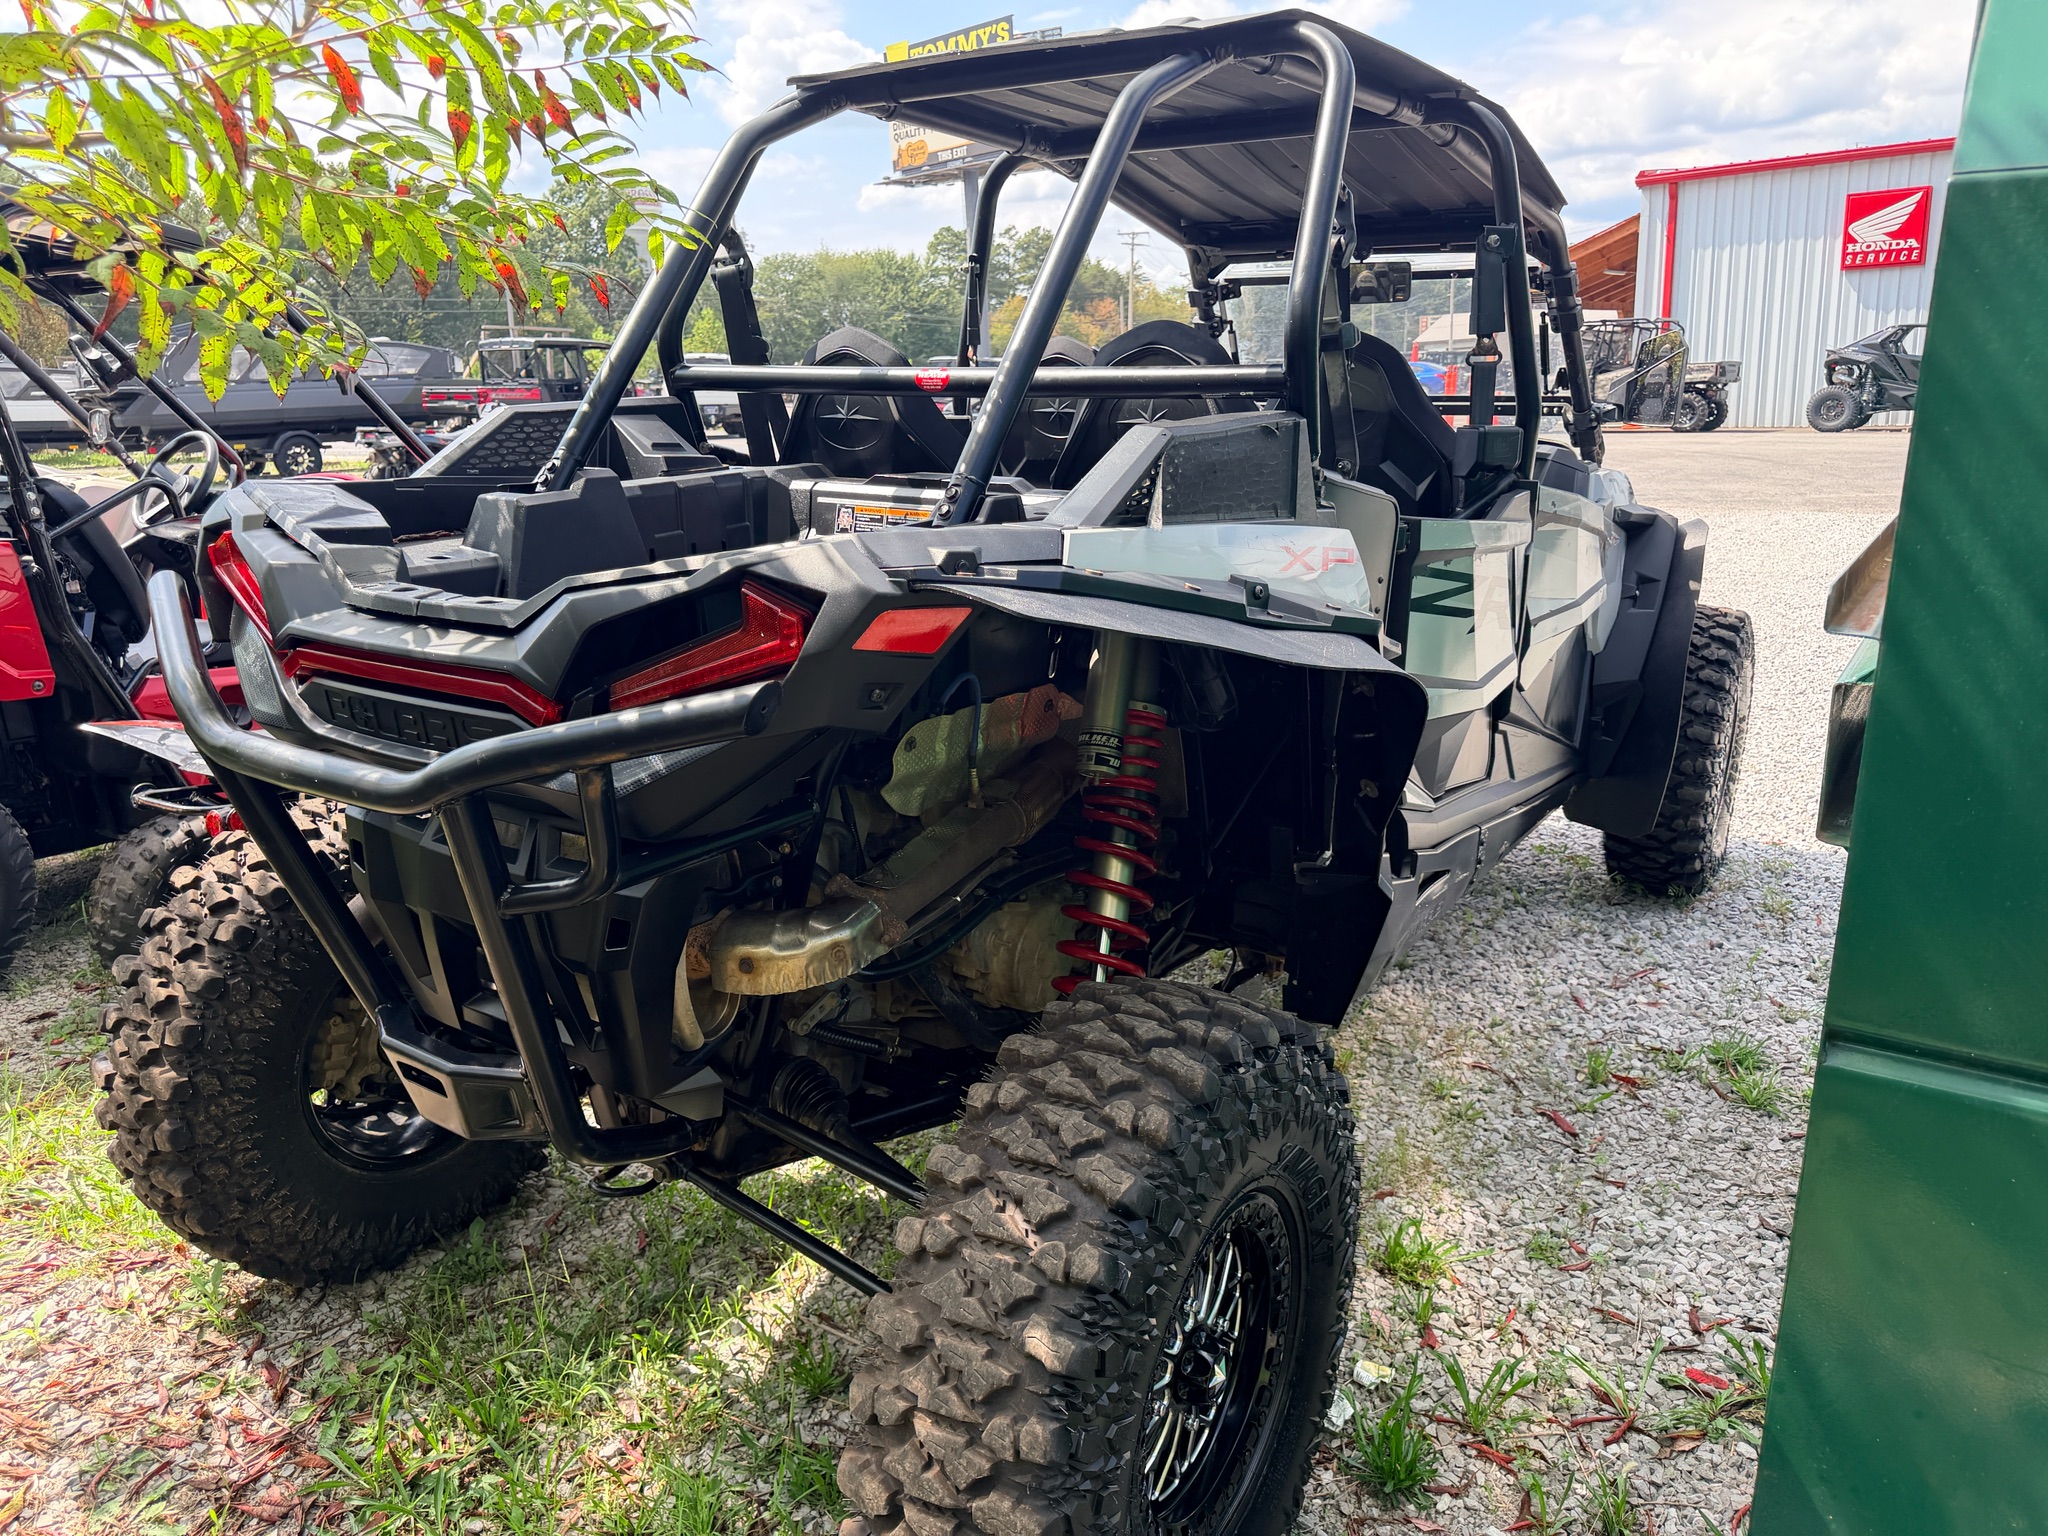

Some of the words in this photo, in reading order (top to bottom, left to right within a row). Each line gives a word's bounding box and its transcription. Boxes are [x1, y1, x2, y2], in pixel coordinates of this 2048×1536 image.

[953, 146, 968, 159] EXIT
[1846, 239, 1921, 253] HONDA
[1845, 250, 1920, 265] SERVICE
[1279, 546, 1356, 572] XP
[1272, 1143, 1331, 1222] SAVAGE
[1311, 1219, 1334, 1268] XT
